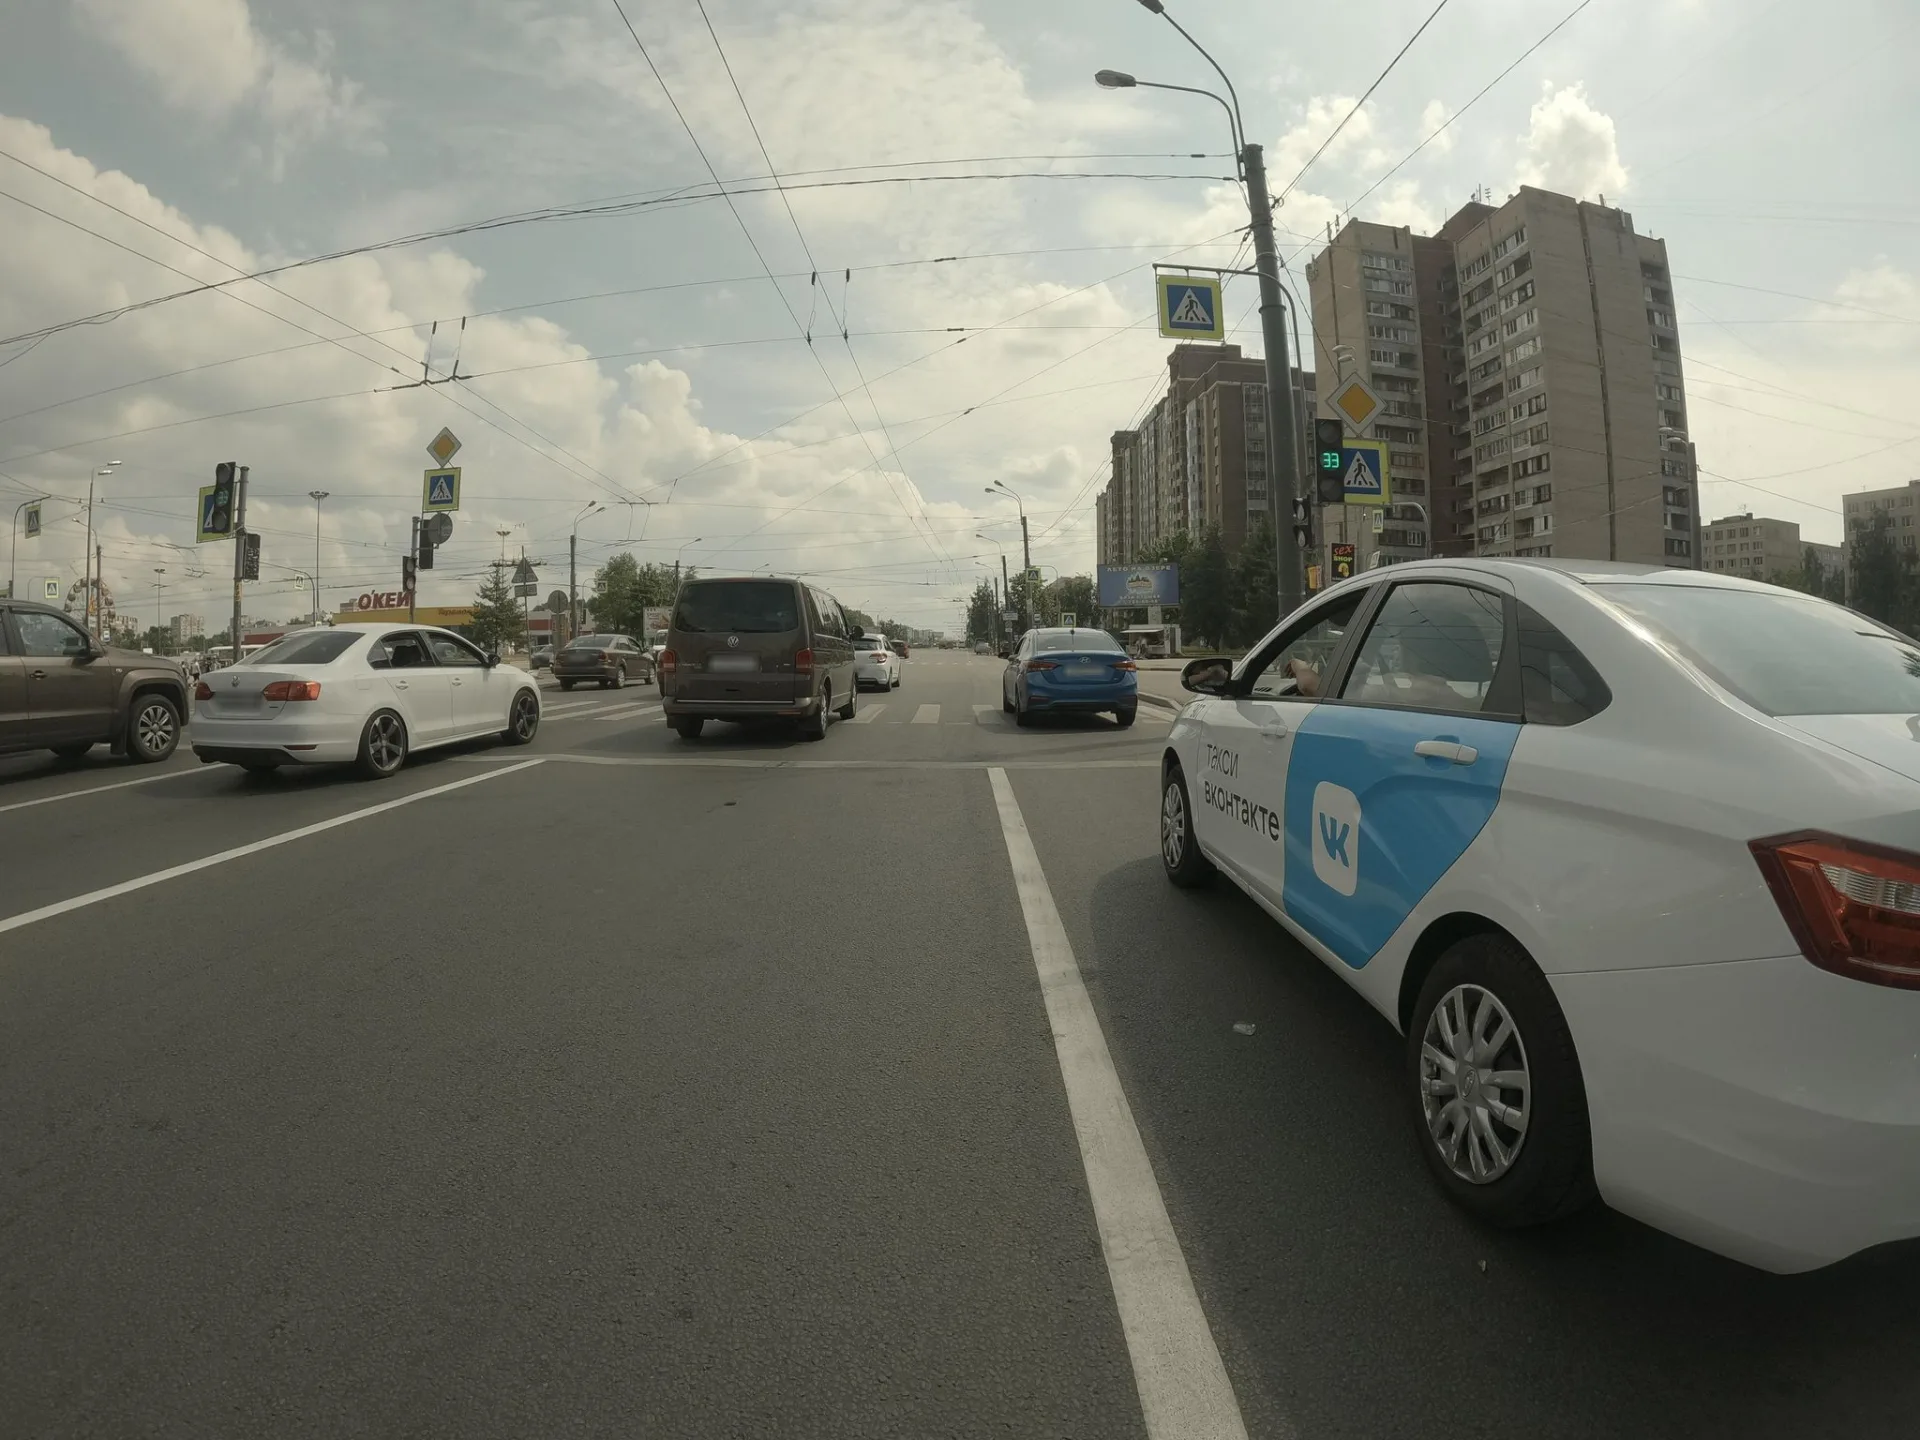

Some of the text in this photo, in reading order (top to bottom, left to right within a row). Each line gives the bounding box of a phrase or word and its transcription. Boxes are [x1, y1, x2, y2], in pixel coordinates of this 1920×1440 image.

[1322, 453, 1339, 469] 33
[1207, 744, 1239, 779] такси
[1204, 780, 1280, 842] вконтакте
